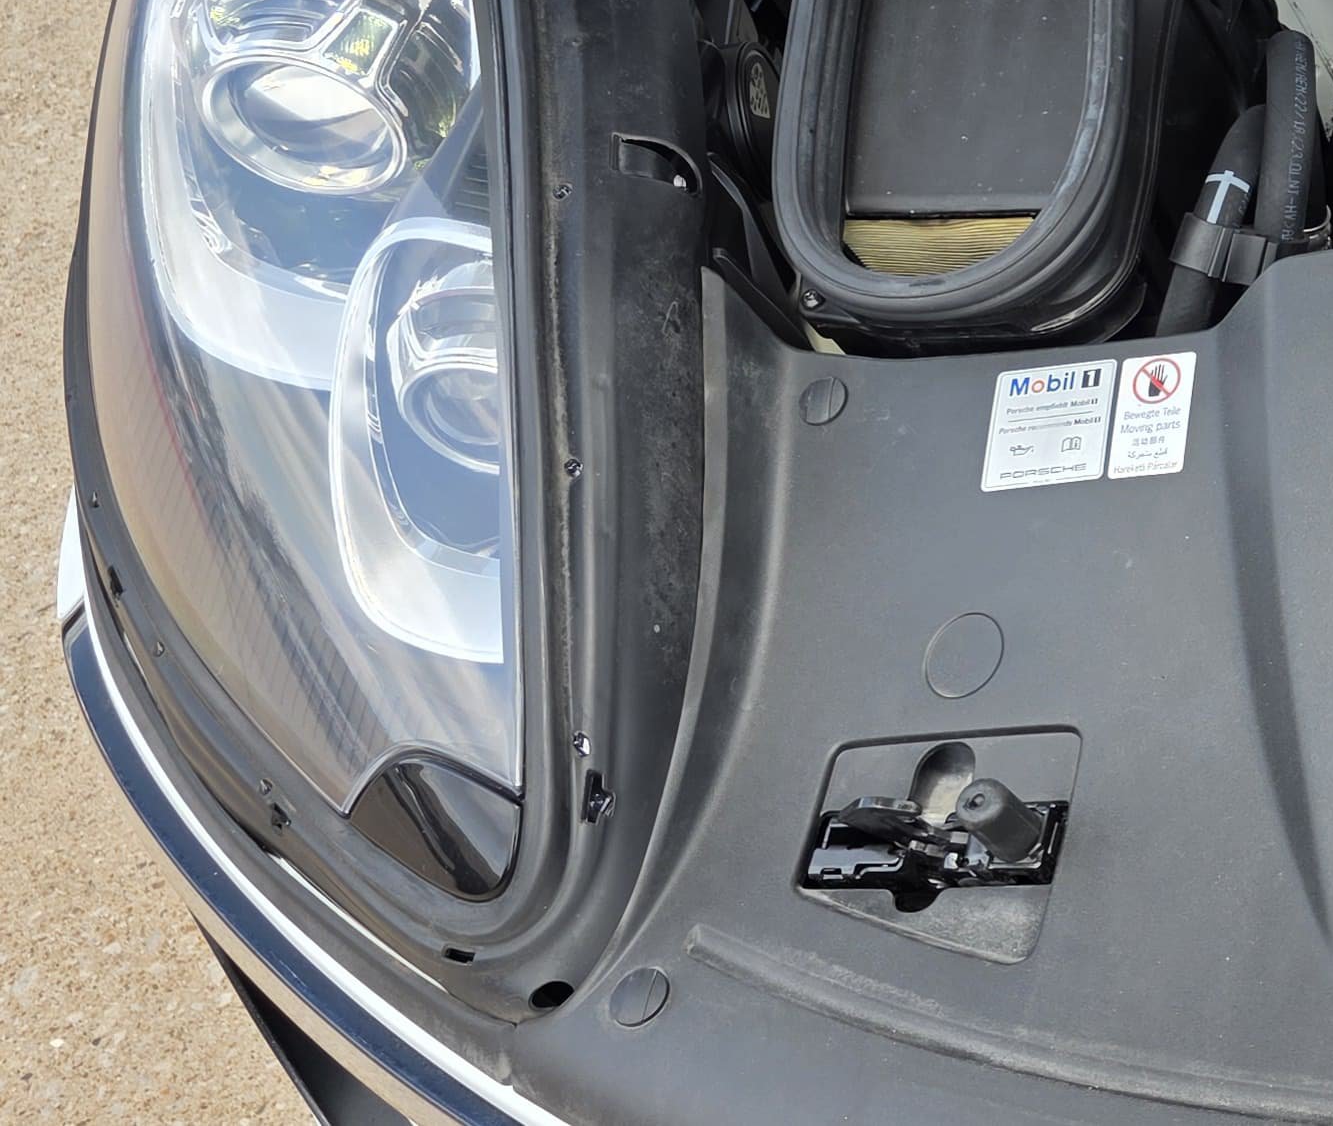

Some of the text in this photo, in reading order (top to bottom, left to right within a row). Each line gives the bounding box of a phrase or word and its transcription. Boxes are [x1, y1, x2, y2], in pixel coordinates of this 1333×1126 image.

[1009, 368, 1102, 397] Mobil 1
[1124, 406, 1181, 420] Bewegte Teile
[1120, 421, 1181, 434] Moving parts
[1000, 463, 1087, 480] PORSCHE
